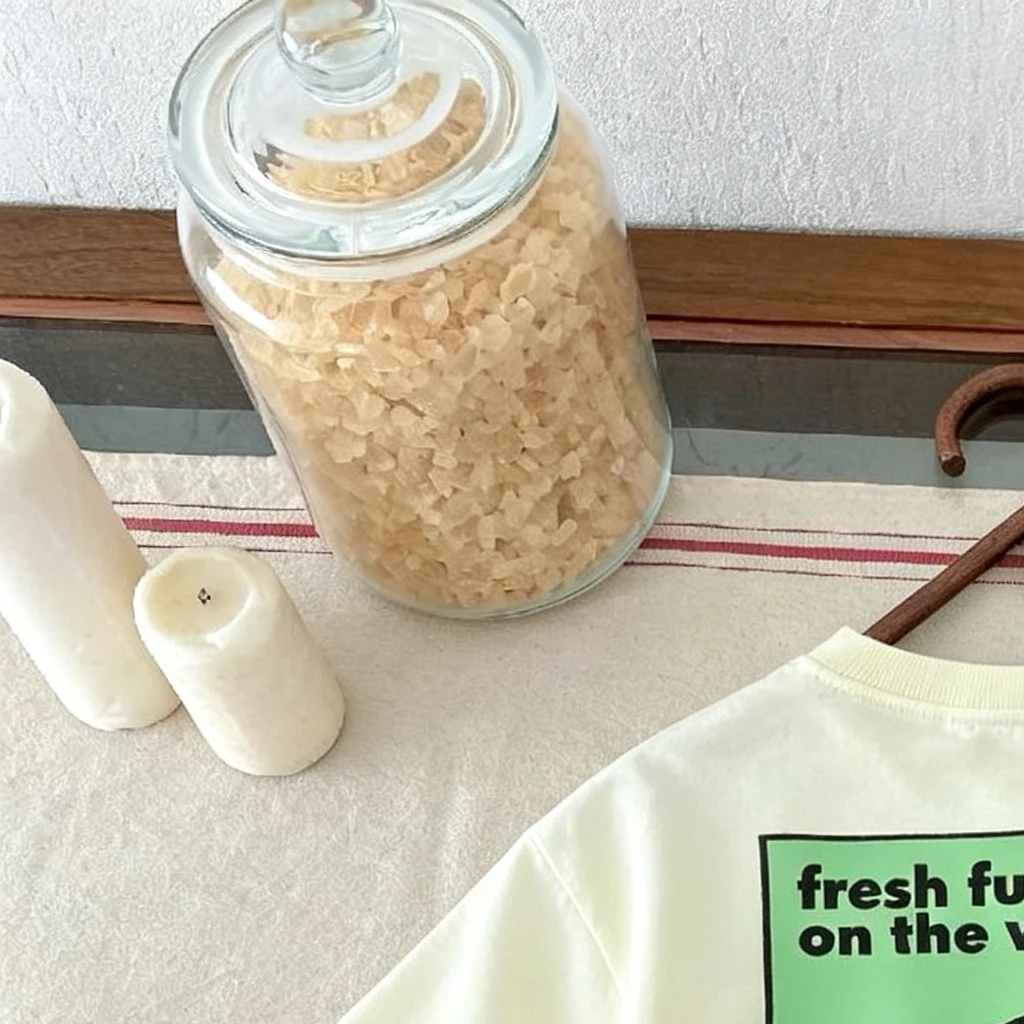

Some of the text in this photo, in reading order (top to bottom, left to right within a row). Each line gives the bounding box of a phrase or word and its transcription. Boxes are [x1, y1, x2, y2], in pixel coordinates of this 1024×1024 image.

[797, 864, 948, 910] fresh
[798, 925, 872, 957] on
[890, 912, 989, 954] the
